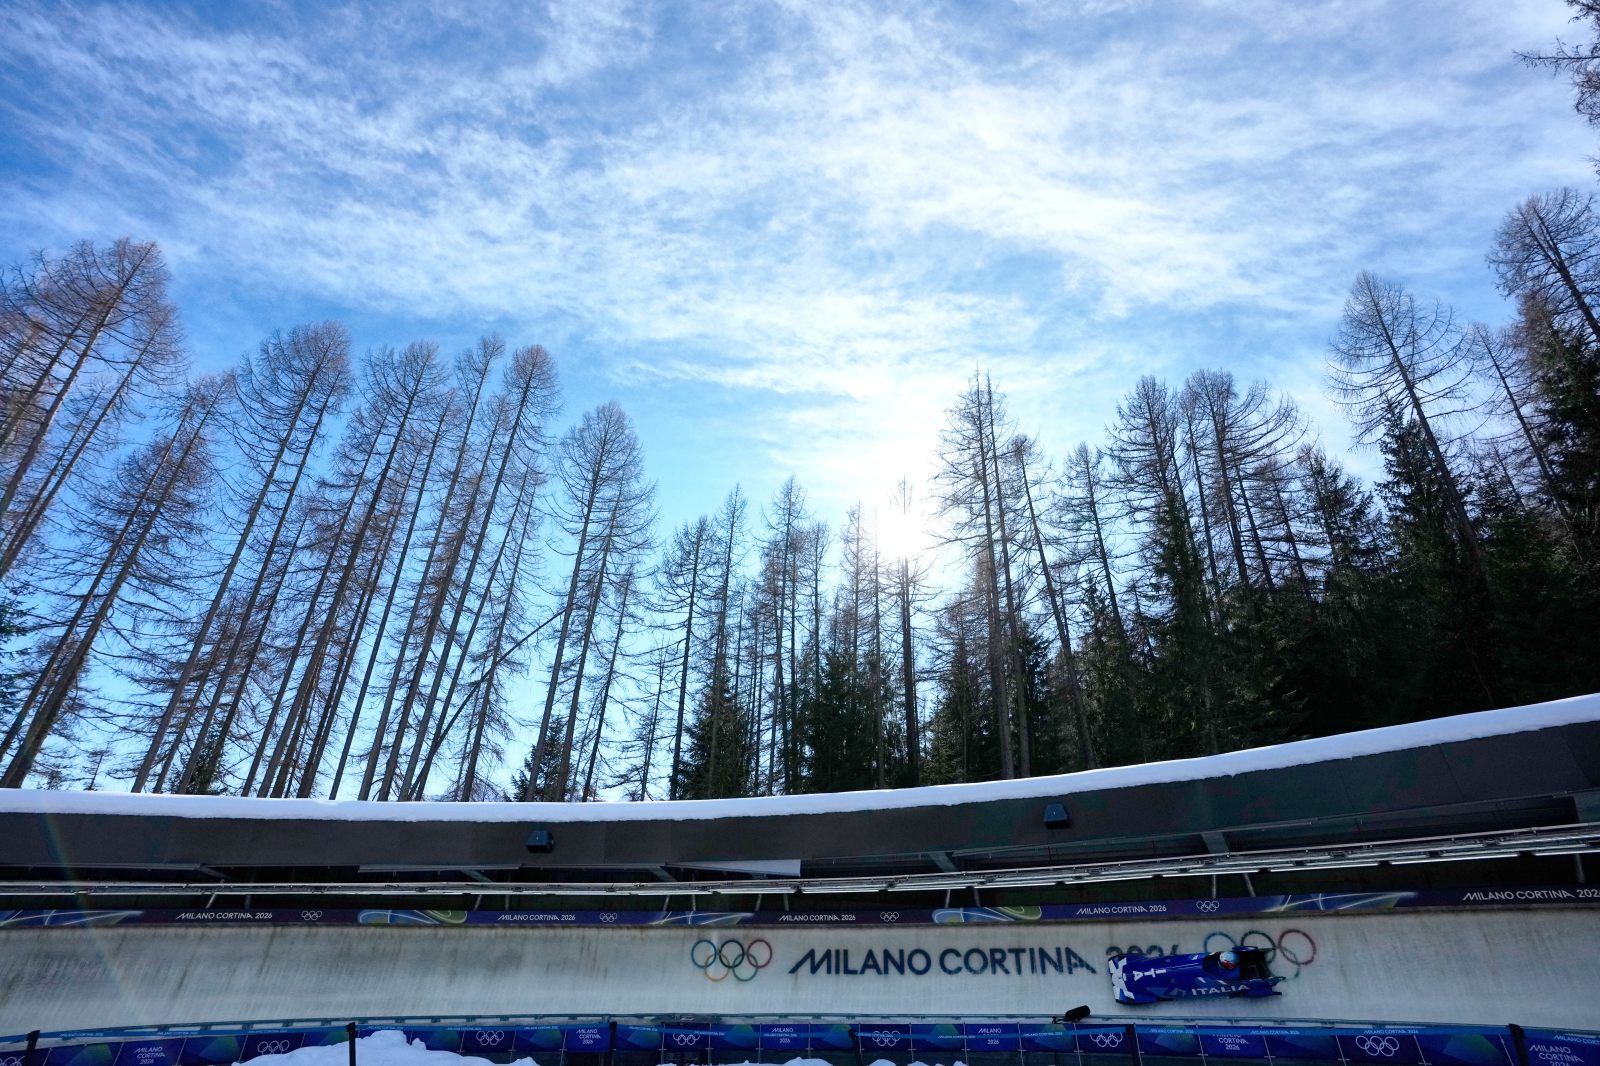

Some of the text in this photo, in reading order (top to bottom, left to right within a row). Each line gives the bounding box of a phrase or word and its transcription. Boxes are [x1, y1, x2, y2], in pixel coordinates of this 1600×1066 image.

[1462, 888, 1600, 901] MILANO CORTINA 202
[1076, 904, 1167, 915] MILANO CORTINA 2026
[176, 912, 215, 920] MILANO
[255, 912, 273, 920] 2026
[788, 948, 932, 976] MILANO
[939, 947, 1097, 976] CORTINA
[1191, 984, 1250, 996] ITALIA
[1218, 1036, 1249, 1044] CORTINA
[1529, 1044, 1571, 1054] MILANO
[1538, 1052, 1585, 1062] CORTINA
